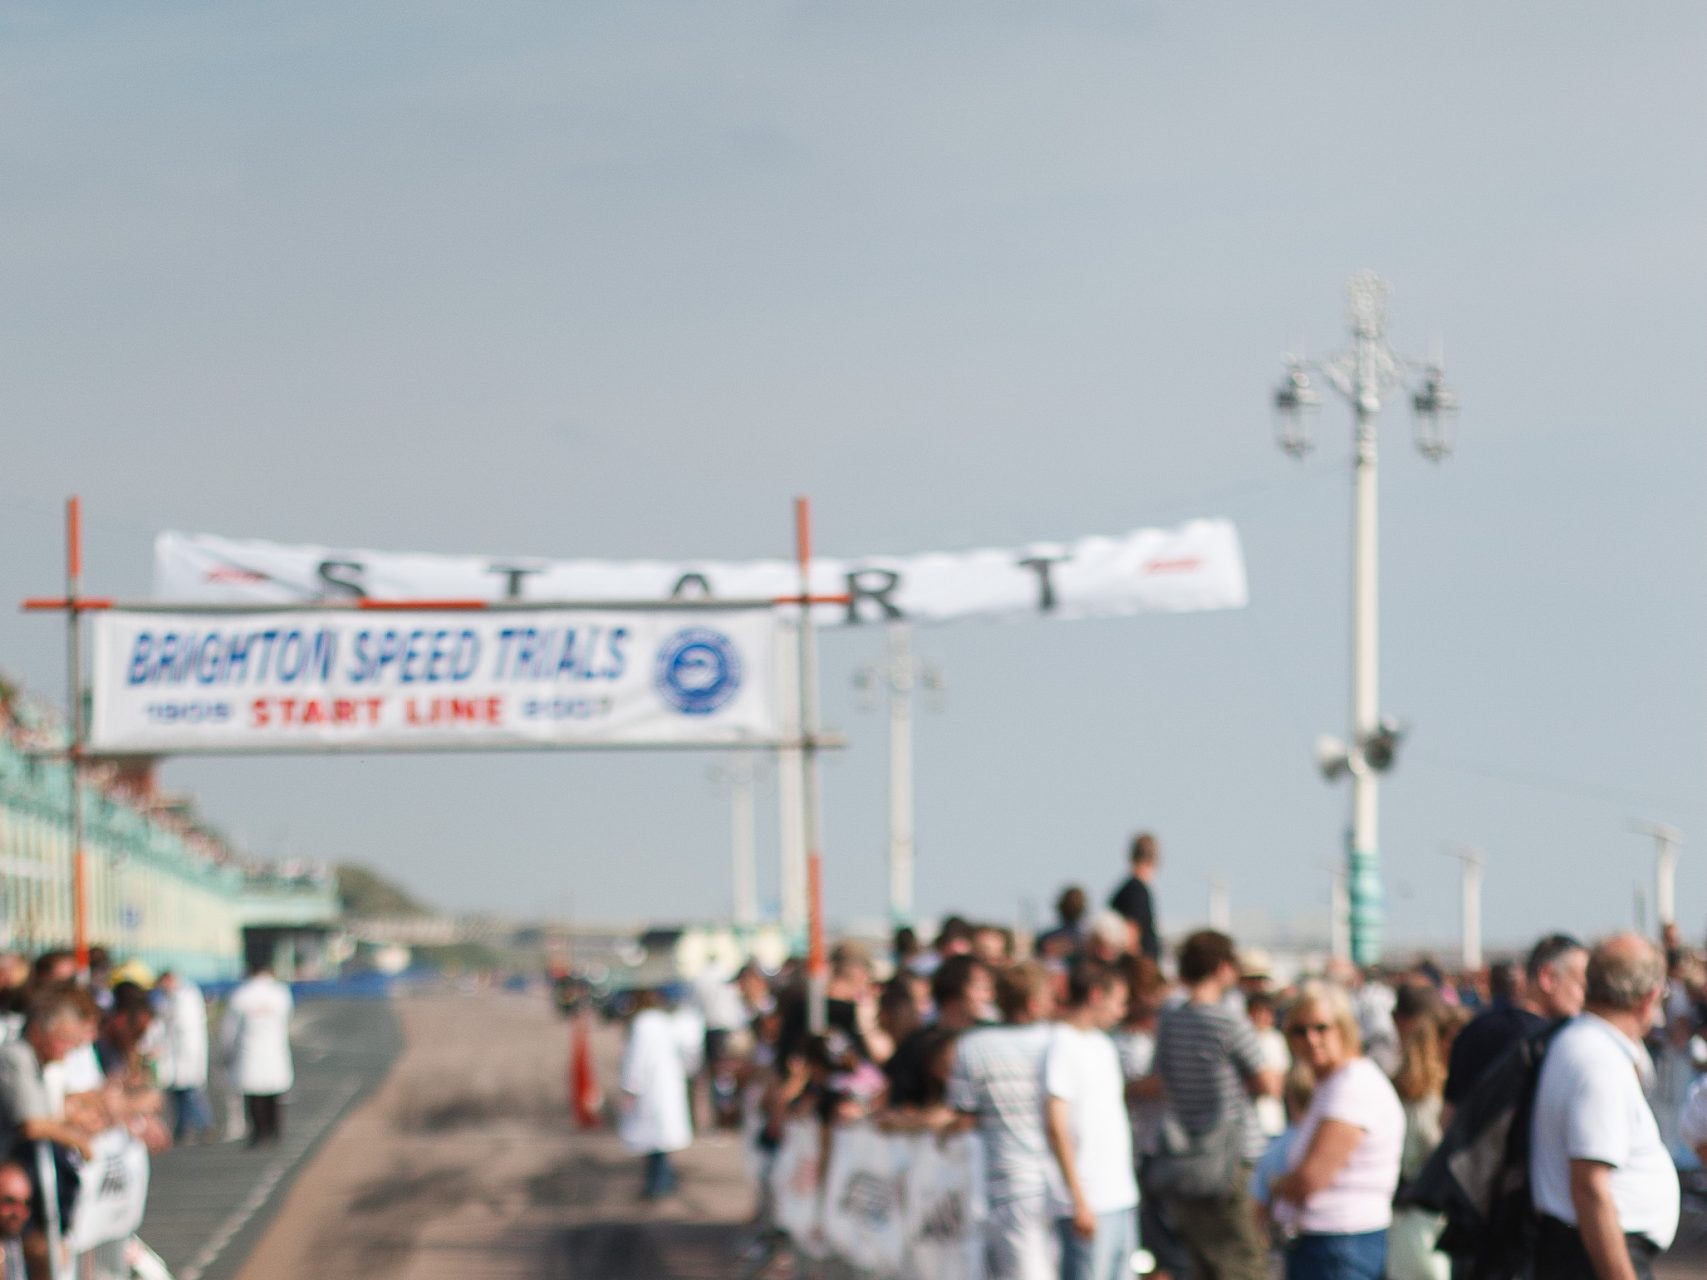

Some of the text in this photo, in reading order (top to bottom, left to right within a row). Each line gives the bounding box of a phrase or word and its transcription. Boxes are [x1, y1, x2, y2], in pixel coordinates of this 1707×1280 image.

[128, 630, 337, 685] BRIGHTON
[346, 628, 481, 684] SPEED
[495, 626, 630, 681] TRIALS
[250, 697, 384, 726] START
[403, 696, 504, 726] LINE
